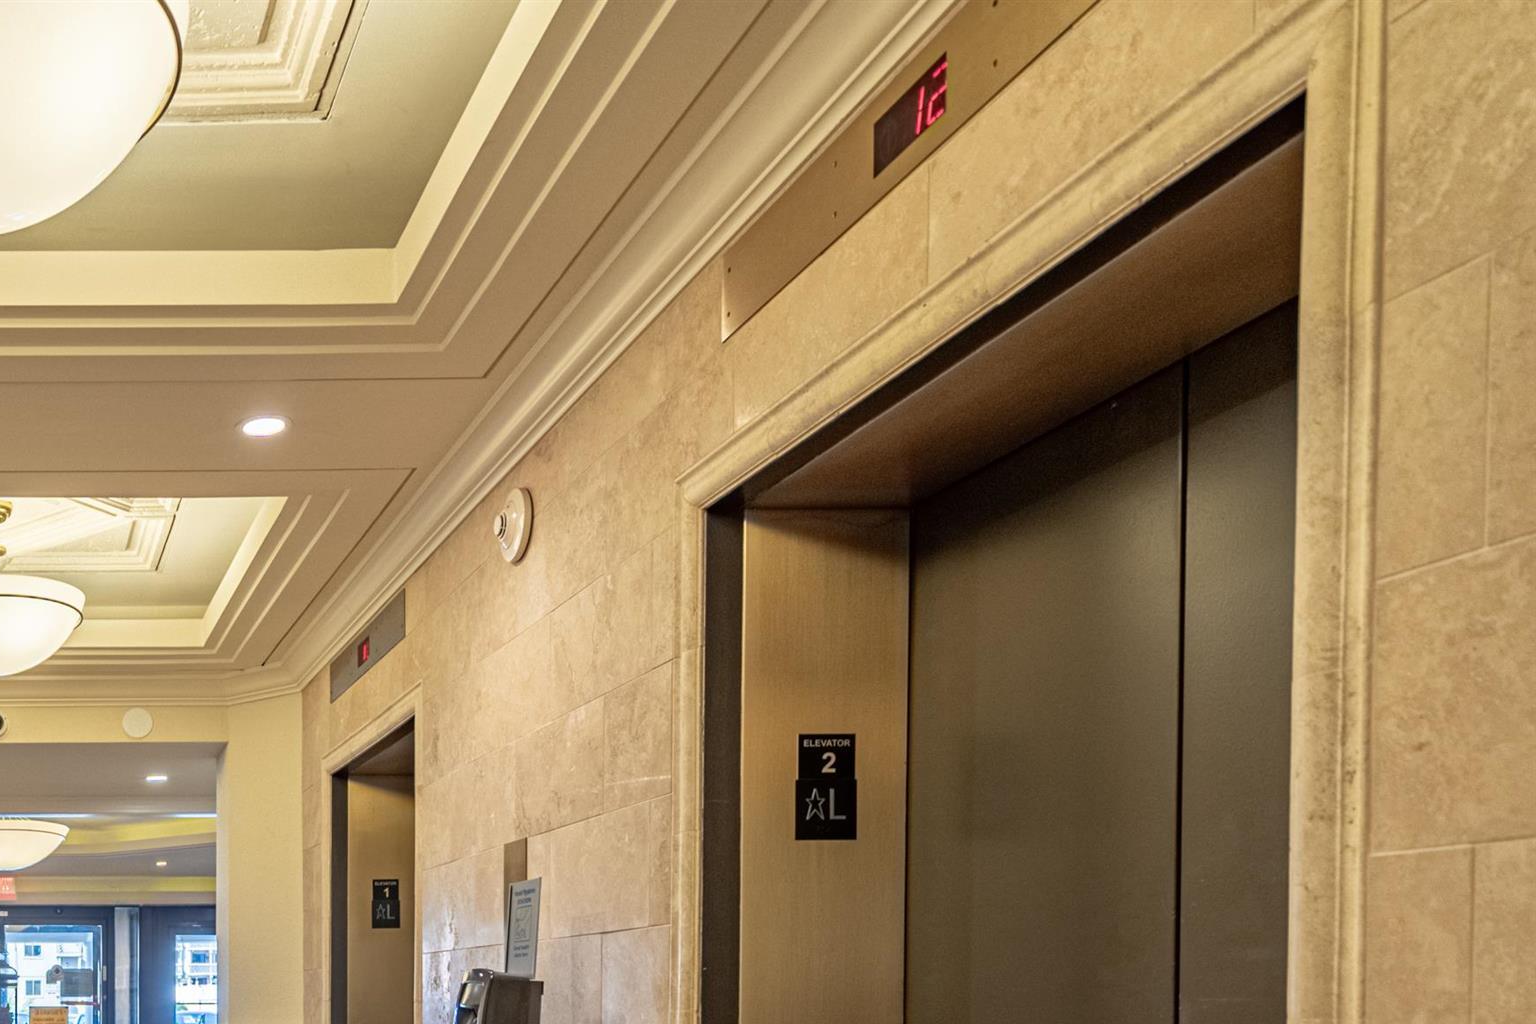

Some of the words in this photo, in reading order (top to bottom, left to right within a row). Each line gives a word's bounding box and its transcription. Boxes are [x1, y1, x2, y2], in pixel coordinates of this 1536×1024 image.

[803, 739, 851, 748] ELEVATOR
[821, 751, 837, 774] 2
[829, 788, 847, 820] L
[383, 887, 390, 899] 1
